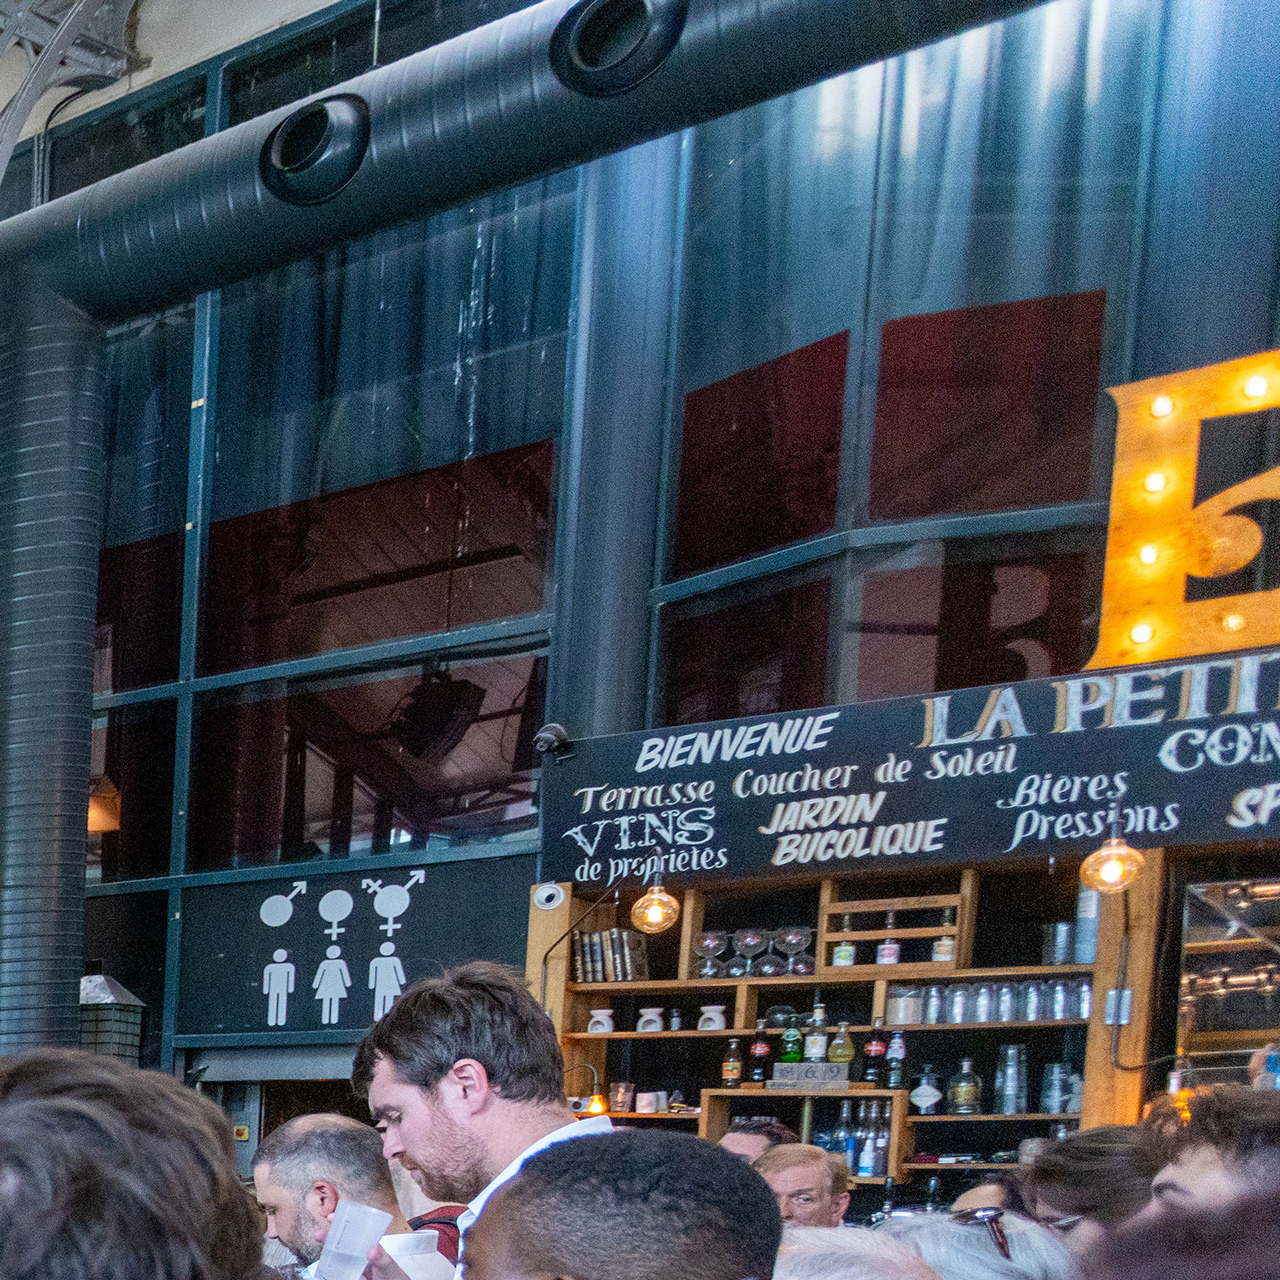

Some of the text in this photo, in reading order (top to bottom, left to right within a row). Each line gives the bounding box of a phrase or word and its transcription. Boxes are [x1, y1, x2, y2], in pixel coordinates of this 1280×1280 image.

[910, 651, 1280, 748] LA PETI
[634, 711, 840, 773] BIENVENUE
[573, 742, 1018, 814] Terrasse Coucher de Soleil
[561, 806, 717, 857] VINS
[758, 791, 887, 835] JARDIN
[1002, 802, 1181, 853] Pressions
[770, 818, 949, 867] BUCOLIQUE
[574, 857, 602, 882] de
